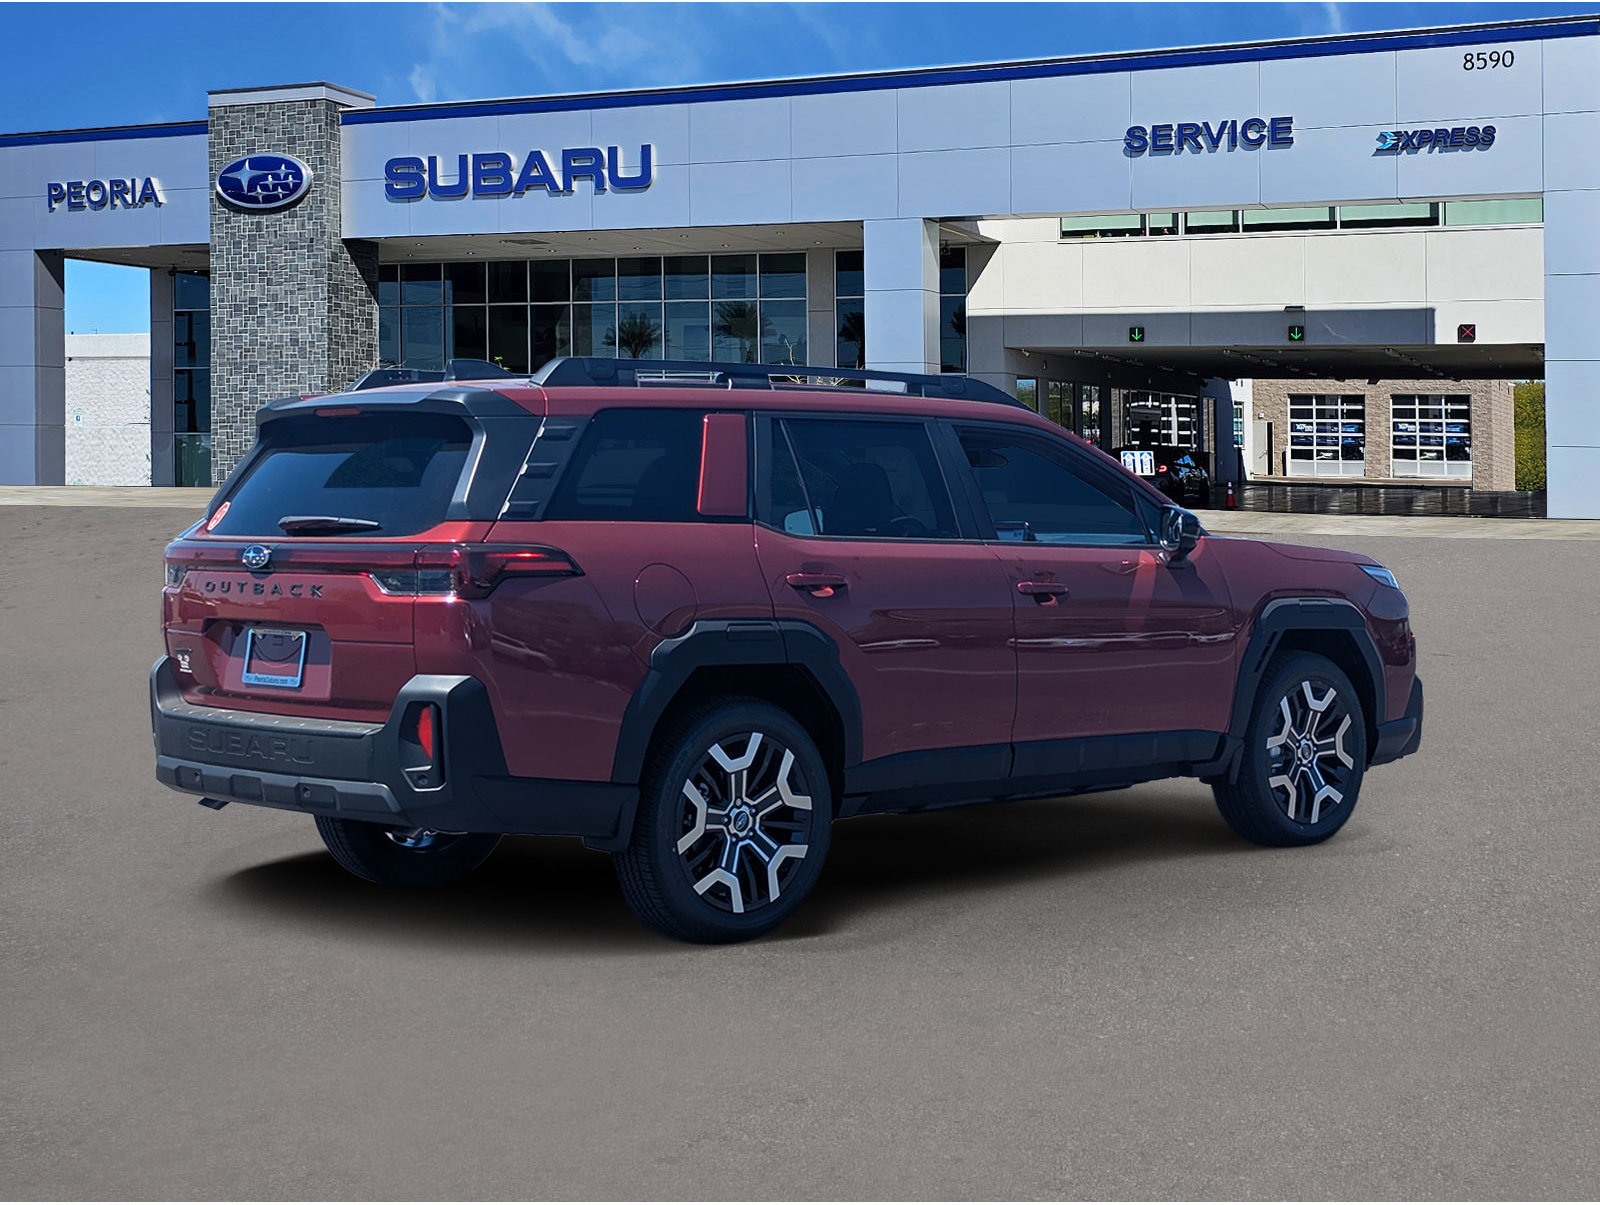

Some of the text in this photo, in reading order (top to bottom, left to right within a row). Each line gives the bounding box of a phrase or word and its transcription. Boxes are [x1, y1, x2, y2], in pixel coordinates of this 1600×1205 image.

[1463, 50, 1515, 71] 8590
[1124, 115, 1294, 157] SERVICE
[1372, 124, 1497, 156] EXPRESS
[384, 144, 656, 202] SUBARU
[47, 176, 164, 212] PEORIA
[205, 581, 323, 598] OUTBACK
[188, 727, 316, 764] SUBARU
